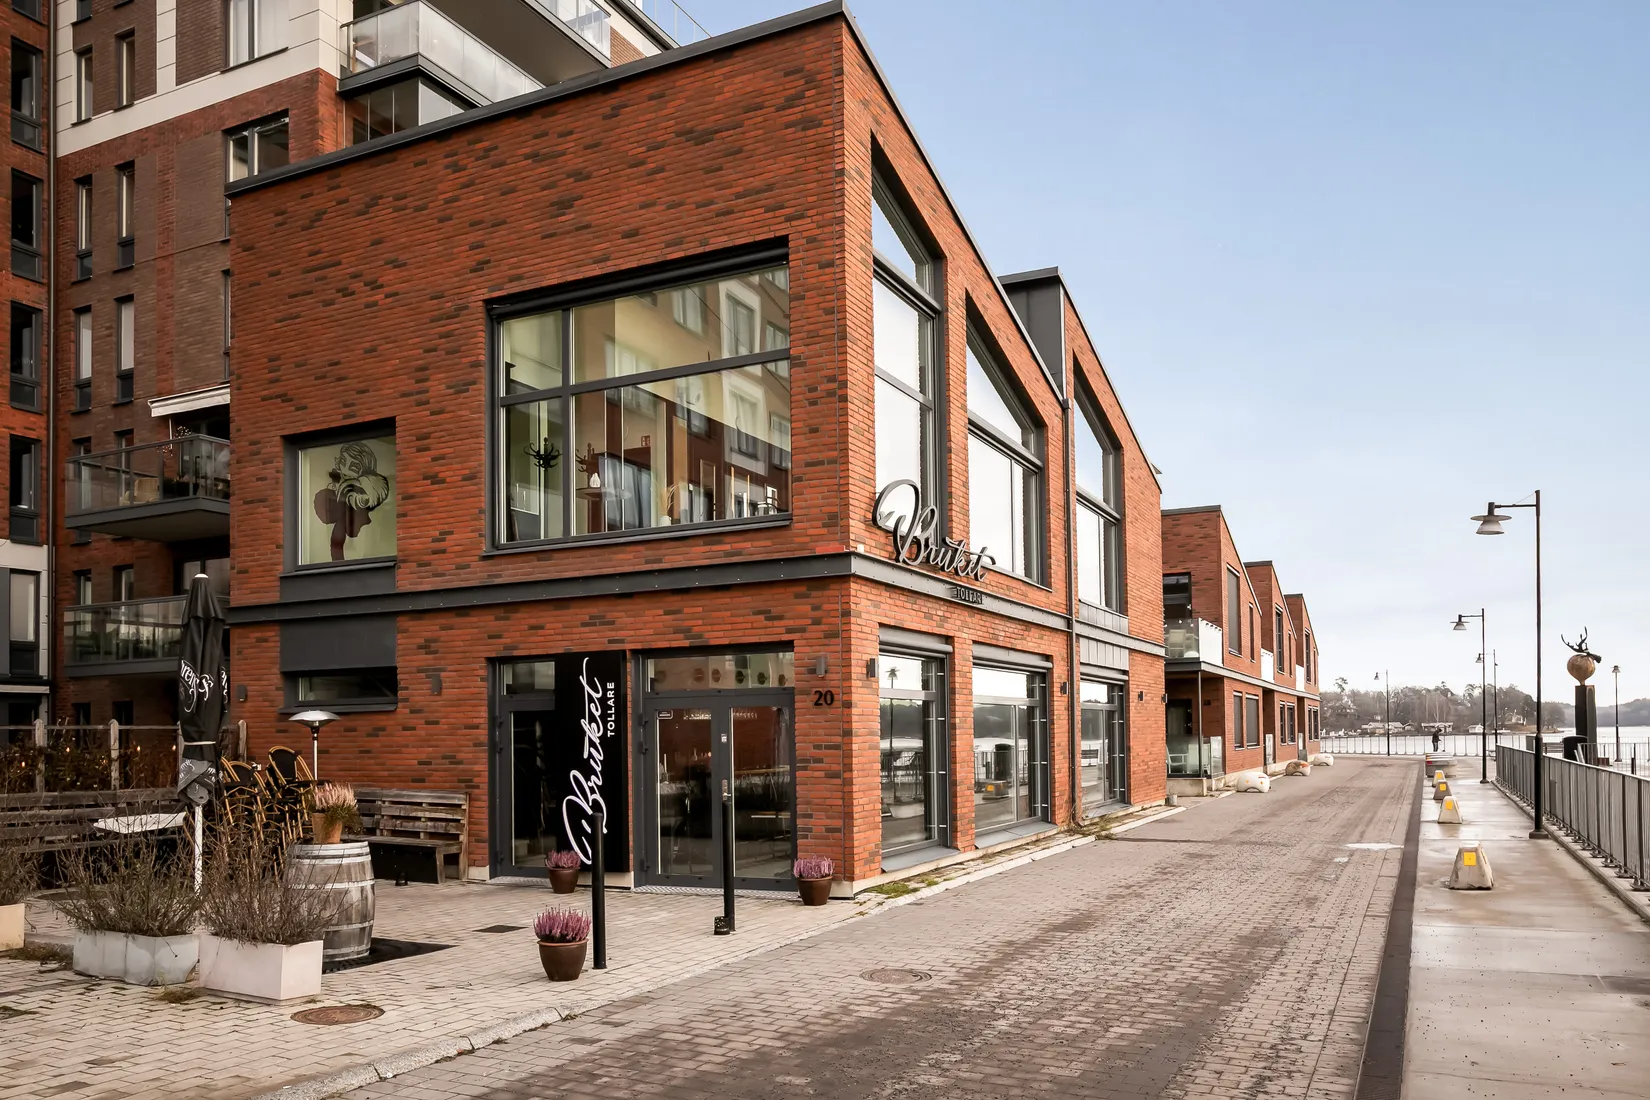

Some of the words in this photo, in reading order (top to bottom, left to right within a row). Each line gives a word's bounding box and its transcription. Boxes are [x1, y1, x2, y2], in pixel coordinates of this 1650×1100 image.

[872, 479, 996, 581] Bruket
[606, 682, 615, 737] TOLLARE
[813, 689, 835, 706] 20
[562, 657, 607, 864] Bruket
